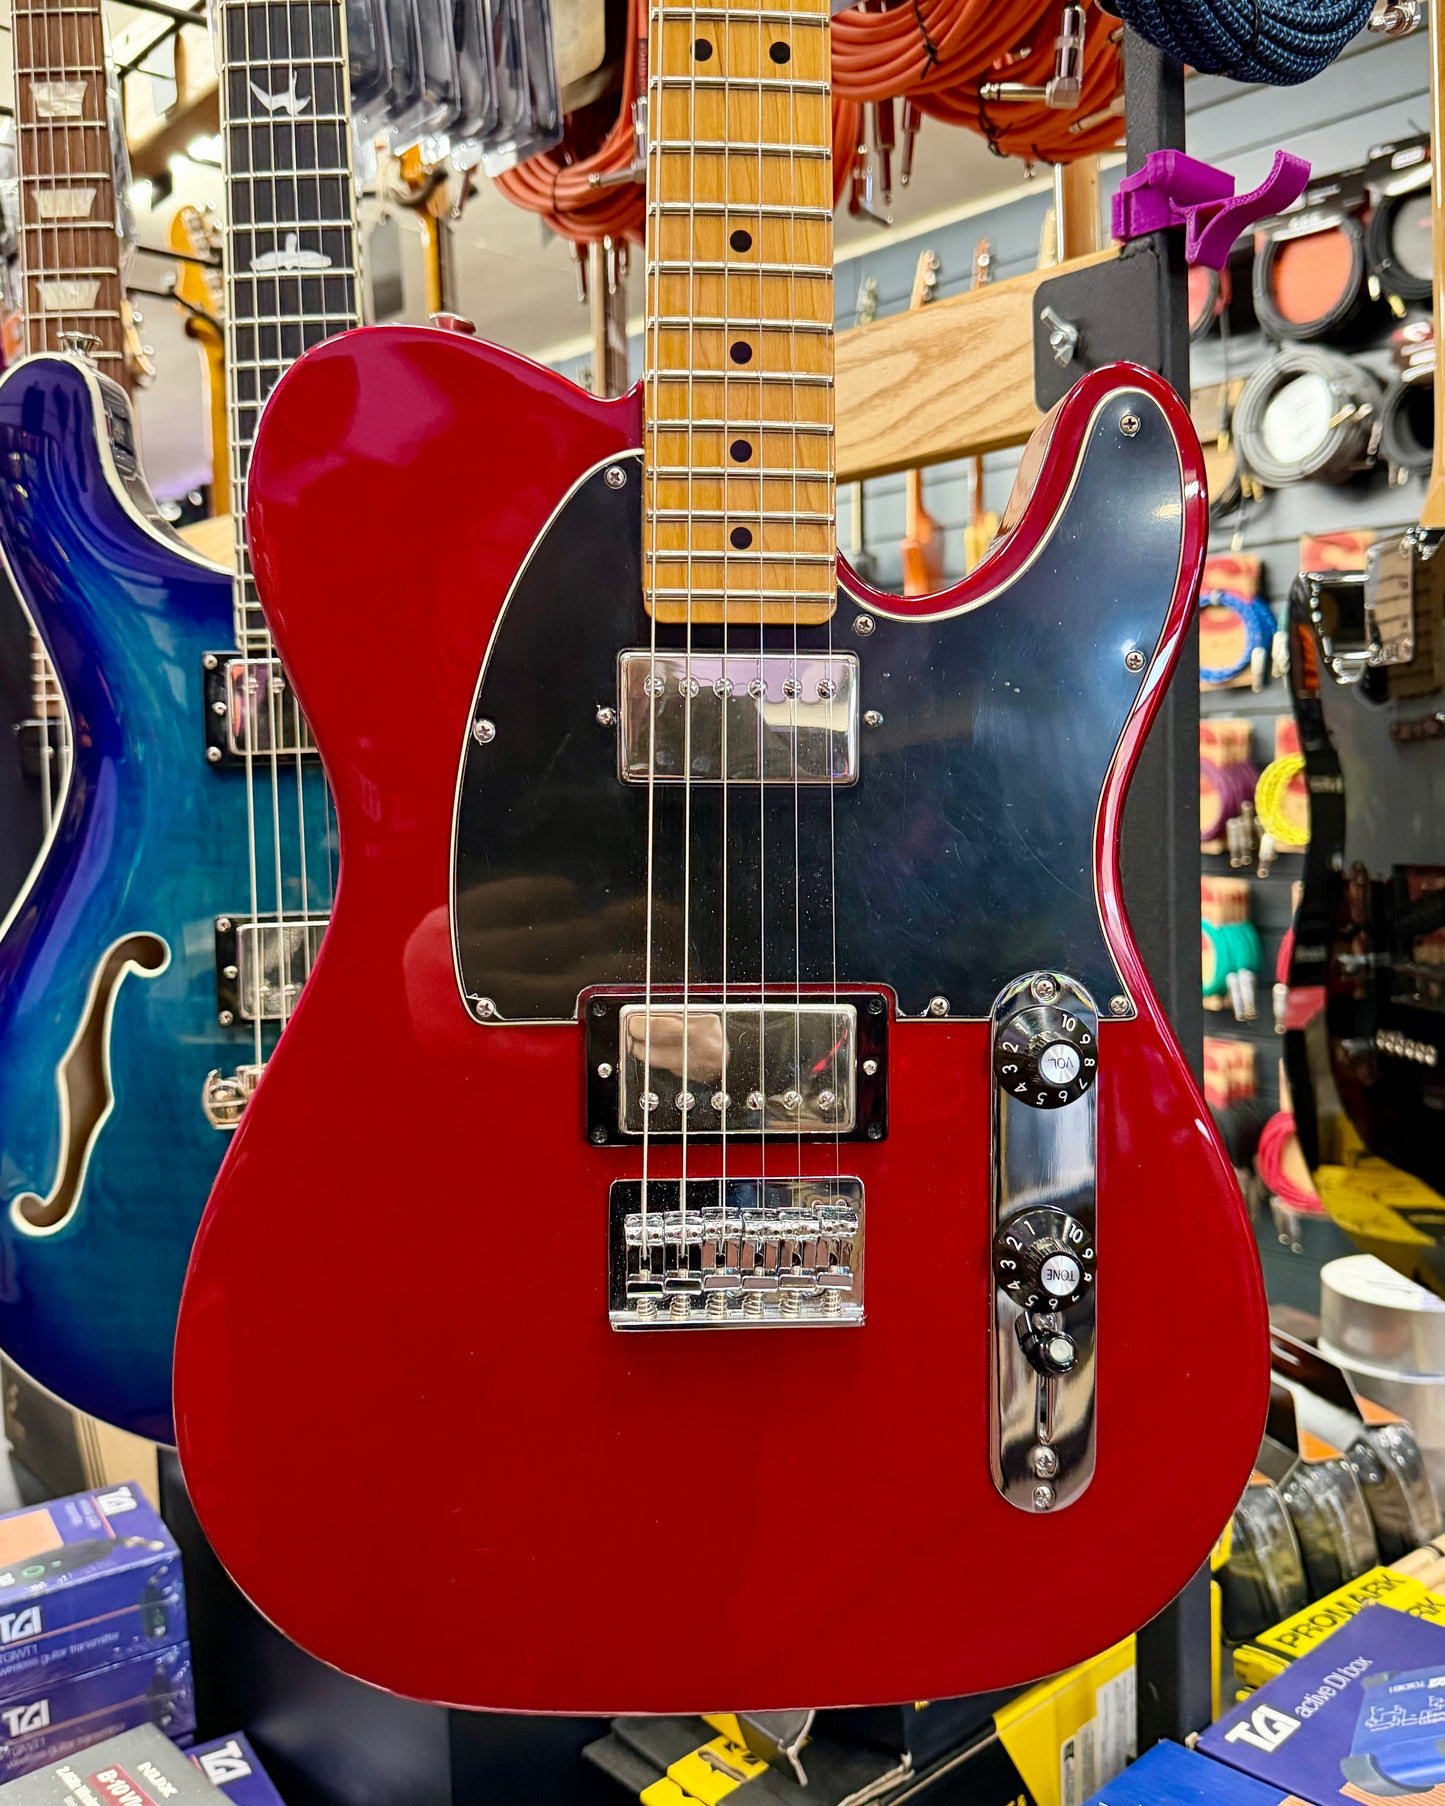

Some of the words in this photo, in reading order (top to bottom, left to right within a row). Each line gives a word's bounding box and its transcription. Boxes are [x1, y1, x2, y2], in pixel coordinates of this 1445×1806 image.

[1015, 1022, 1029, 1035] 1
[1061, 1013, 1076, 1032] 10
[1079, 1033, 1091, 1045] 9
[1002, 1041, 1019, 1054] 2
[1047, 1056, 1074, 1069] VOL
[1083, 1057, 1096, 1067] 8
[1001, 1064, 1018, 1075] 3
[1014, 1082, 1028, 1093] 4
[1078, 1078, 1088, 1090] 7
[1036, 1092, 1048, 1105] 5
[1058, 1090, 1069, 1103] 6
[1023, 1220, 1036, 1236] 1
[1068, 1223, 1084, 1244] 10
[1005, 1235, 1023, 1251] 2
[1081, 1247, 1094, 1260] 9
[1000, 1259, 1017, 1271] 3
[1046, 1268, 1076, 1282] TONE
[1006, 1279, 1021, 1291] 4
[1025, 1294, 1039, 1308] 5
[1048, 1298, 1059, 1310] 6
[1274, 1574, 1407, 1649] PROMARK
[0, 1605, 43, 1645] TGI
[1336, 1656, 1374, 1679] box
[1323, 1671, 1352, 1691] DI
[1294, 1686, 1338, 1719] active
[1, 1698, 51, 1738] TGI
[1223, 1703, 1302, 1753] TGI
[199, 1740, 253, 1785] TGI
[137, 1761, 178, 1799] NUX
